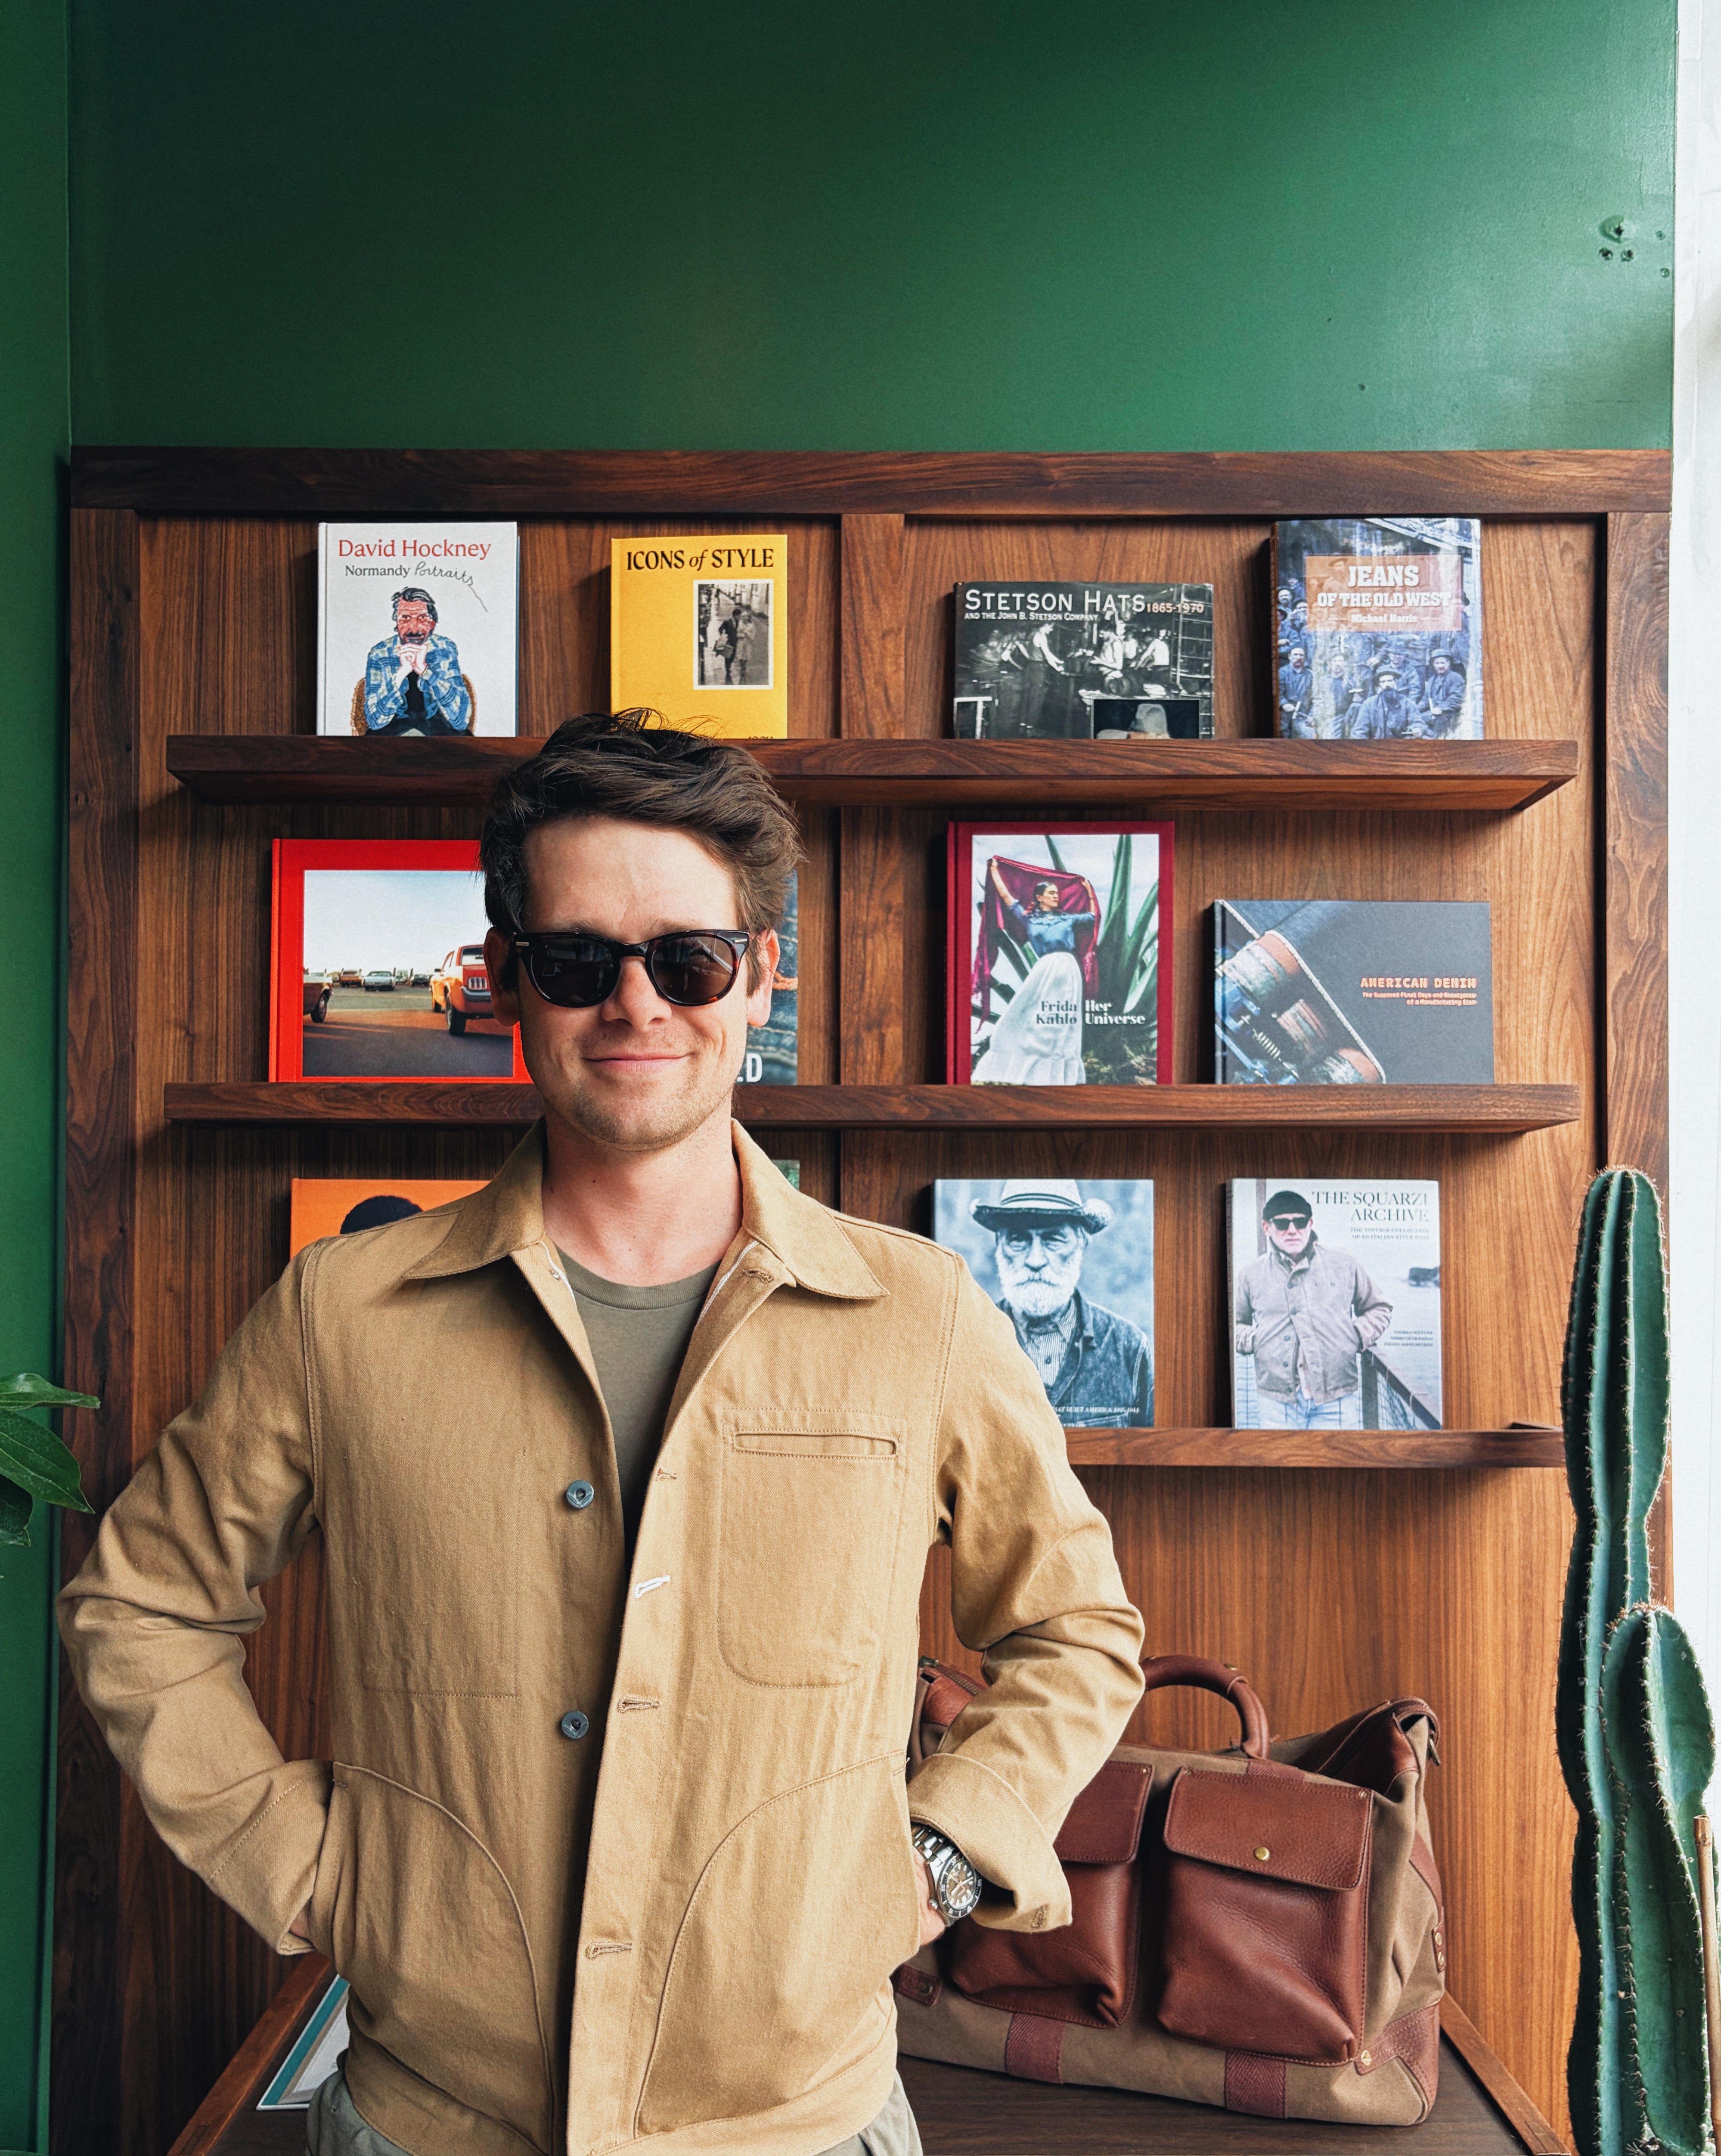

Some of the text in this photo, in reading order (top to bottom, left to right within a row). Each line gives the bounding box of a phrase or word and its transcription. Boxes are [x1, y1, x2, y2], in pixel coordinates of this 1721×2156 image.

[338, 539, 492, 560] David Hockney
[627, 549, 774, 571] ICONS of STYLE
[345, 565, 410, 578] Normandy
[1348, 565, 1420, 587] JEANS
[965, 589, 1205, 613] STETSON HATS 1865-1970
[1317, 592, 1451, 607] OF THE OLD WEST
[1064, 612, 1099, 620] COMPANY
[1351, 614, 1417, 623] Michael Harris
[1360, 977, 1477, 988] AMERICAN DENIM
[1041, 1000, 1077, 1011] Frida
[1085, 999, 1112, 1011] Her
[1036, 1013, 1077, 1024] Kahlo
[1085, 1012, 1146, 1024] Universe
[1312, 1191, 1427, 1207] THE SQUARZI
[1350, 1209, 1429, 1221] ARCHIVE
